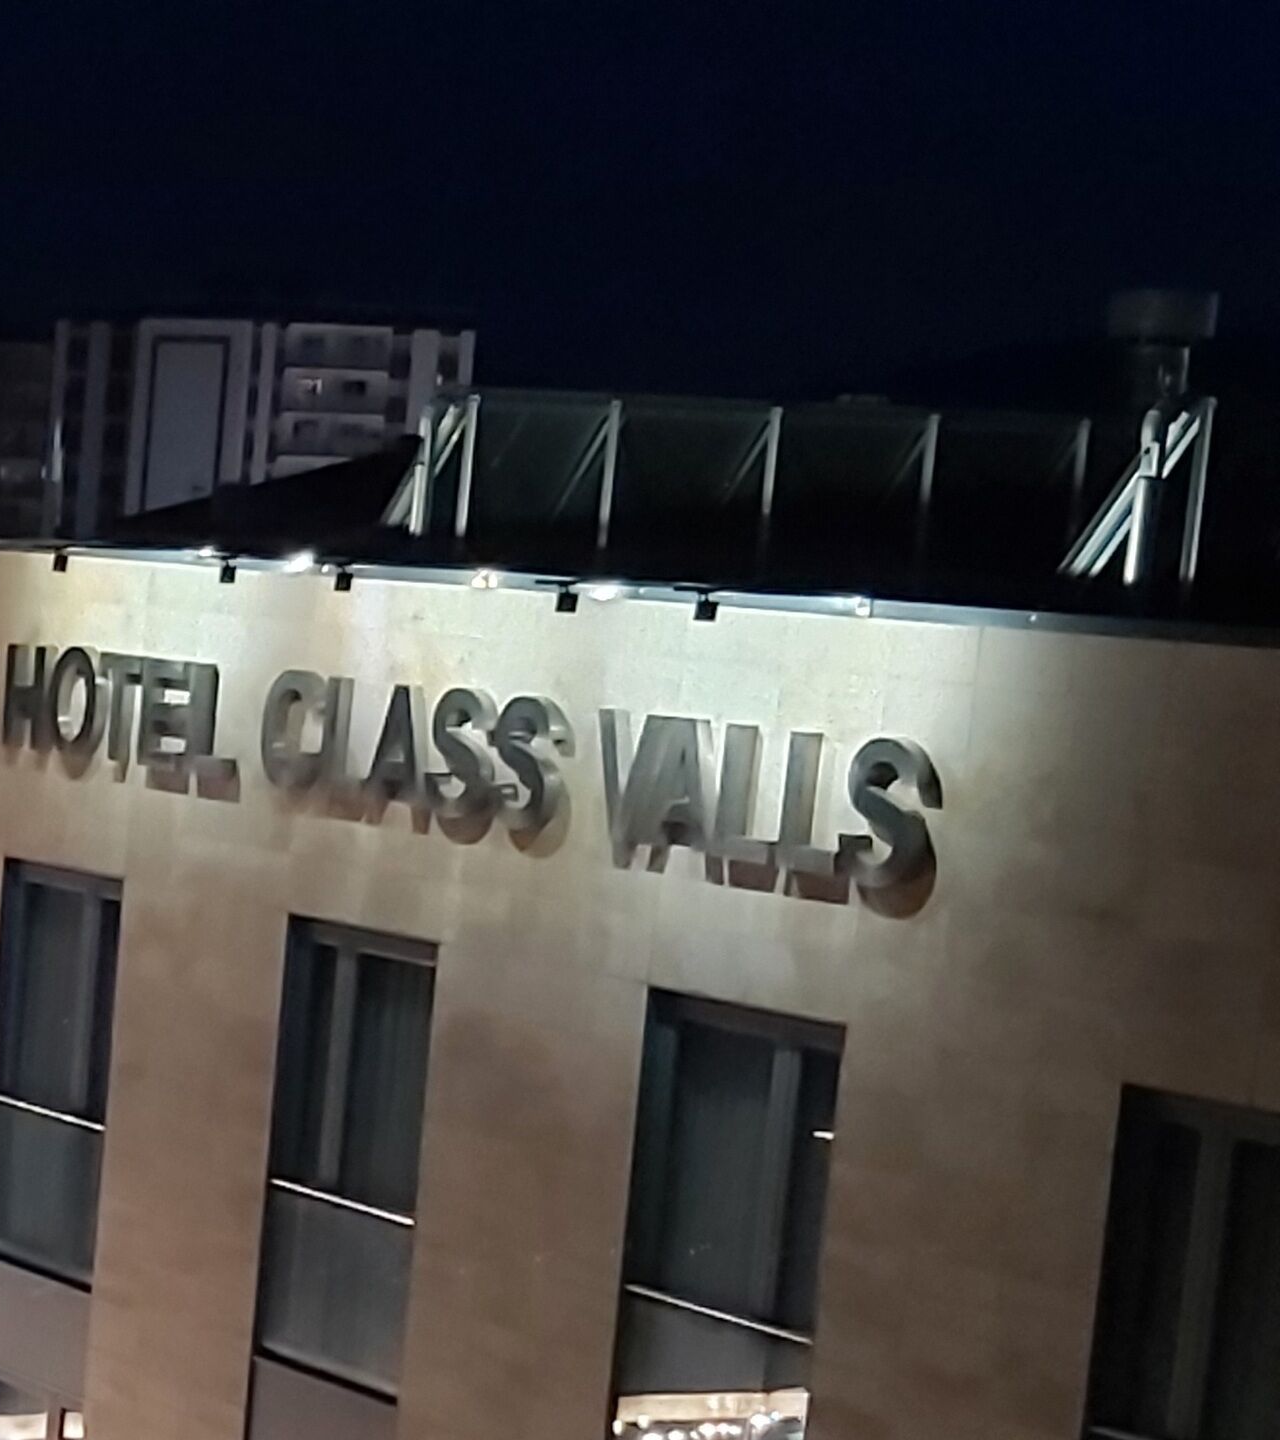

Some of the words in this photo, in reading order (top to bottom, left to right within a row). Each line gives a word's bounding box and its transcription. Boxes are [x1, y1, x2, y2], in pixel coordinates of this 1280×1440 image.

[2, 643, 239, 793] HOTEL
[261, 669, 575, 848] CLASS
[598, 707, 943, 912] VALLS
